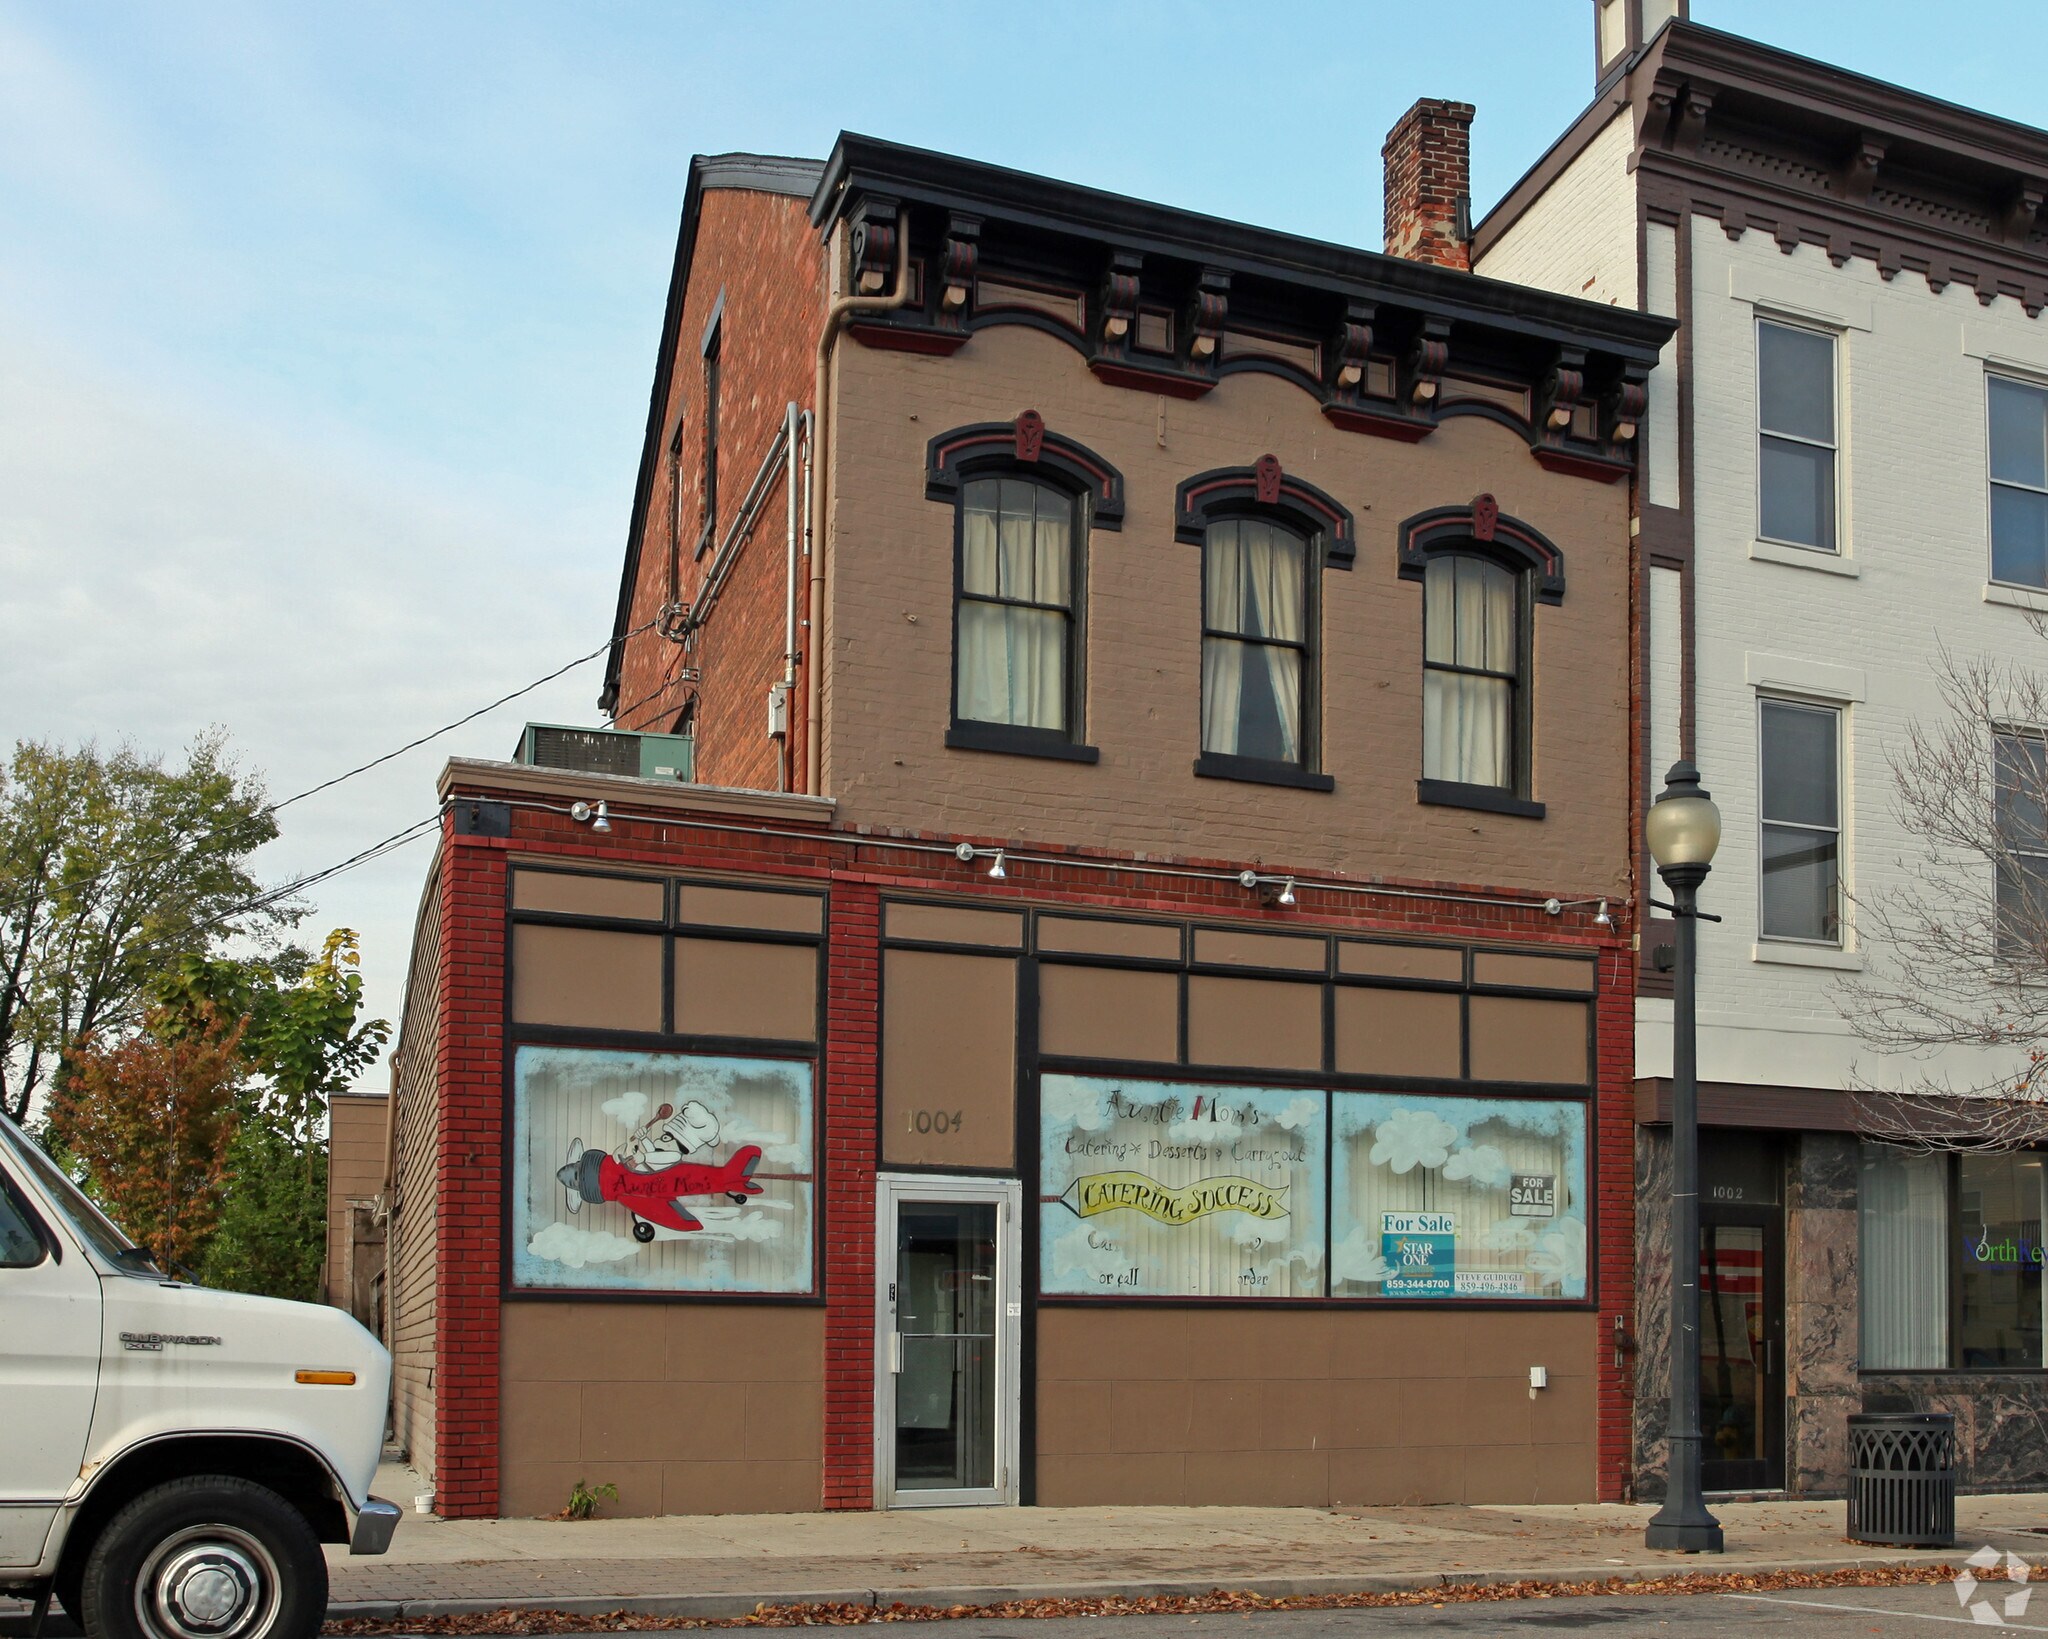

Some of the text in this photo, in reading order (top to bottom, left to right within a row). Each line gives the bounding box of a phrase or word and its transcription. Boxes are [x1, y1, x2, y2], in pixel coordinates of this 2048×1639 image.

[1104, 1090, 1259, 1125] Auntie Mom's
[907, 1109, 962, 1134] 1004
[1065, 1138, 1127, 1162] Catering
[1148, 1141, 1207, 1160] Desserts
[1523, 1177, 1544, 1188] FOR
[1511, 1188, 1553, 1204] SALE
[1713, 1186, 1743, 1199] 1002
[1187, 1185, 1273, 1216] SUCCESS
[1384, 1215, 1452, 1232] For Sale
[1403, 1242, 1433, 1254] STAR
[1403, 1254, 1429, 1266] ONE
[1099, 1273, 1114, 1285] or
[1387, 1280, 1449, 1288] 859-344-8700
[1461, 1282, 1518, 1291] 859-496-4846
[127, 1342, 160, 1350] XLT
[162, 1335, 222, 1345] WAGON
